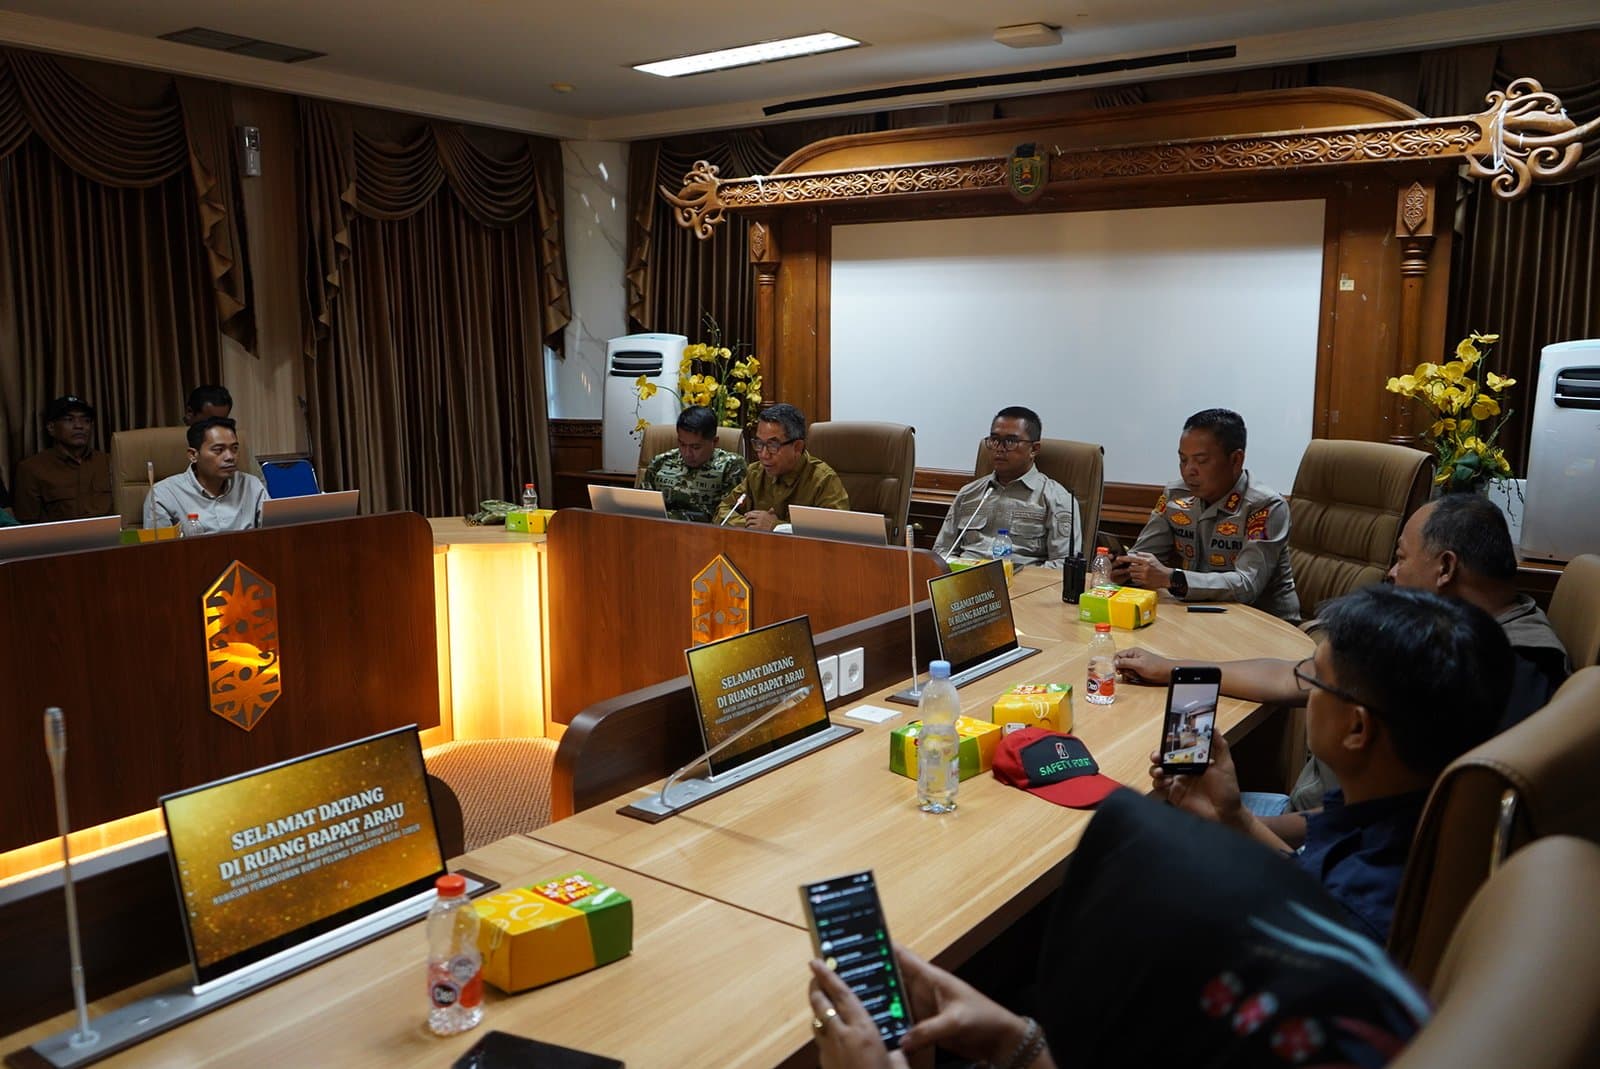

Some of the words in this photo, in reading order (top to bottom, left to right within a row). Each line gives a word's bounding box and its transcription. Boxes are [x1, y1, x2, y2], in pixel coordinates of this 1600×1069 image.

[1211, 538, 1243, 551] POLRI
[716, 694, 728, 709] DI
[727, 684, 758, 706] RUANG
[758, 674, 784, 694] RAPAT
[784, 667, 806, 684] ARAU
[722, 667, 762, 689] SELAMAT
[762, 656, 794, 675] DATANG
[1039, 759, 1073, 777] SAFETY
[231, 808, 317, 851] SELAMAT
[318, 786, 385, 821] DATANG
[219, 858, 242, 880] DI
[243, 836, 306, 872] RUANG
[307, 817, 361, 849] RAPAT
[363, 802, 405, 830] ARAU
